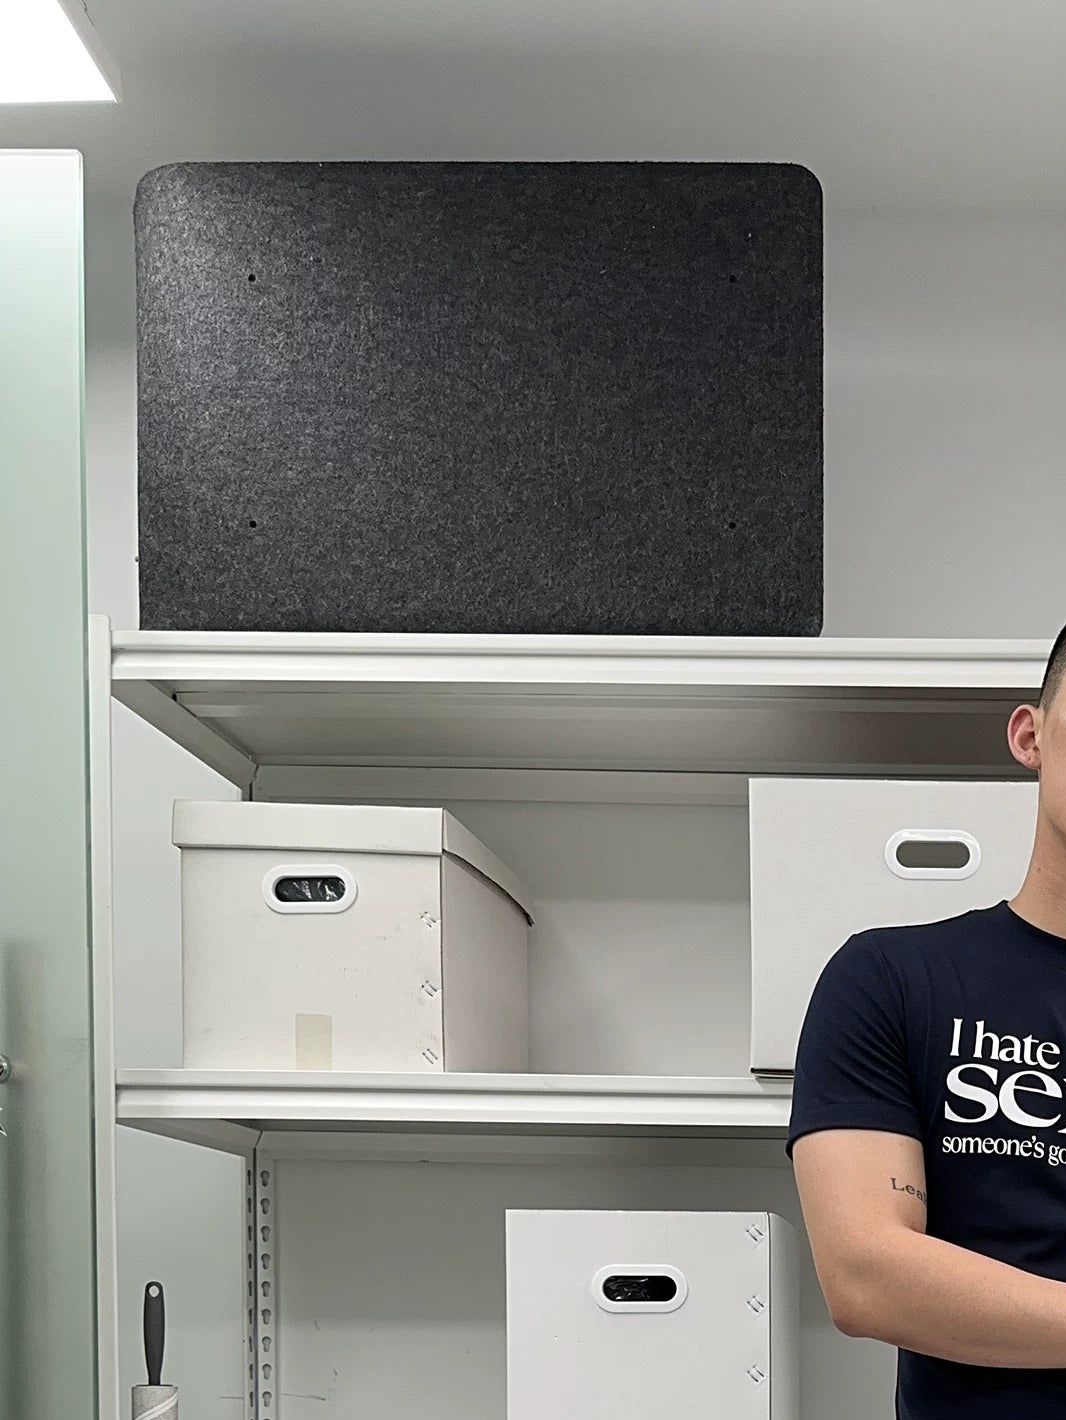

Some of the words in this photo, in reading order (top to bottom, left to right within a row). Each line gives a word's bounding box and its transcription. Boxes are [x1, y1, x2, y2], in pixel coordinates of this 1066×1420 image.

[949, 1017, 963, 1057] I
[972, 1020, 1061, 1070] hate
[942, 1135, 1045, 1159] someone's
